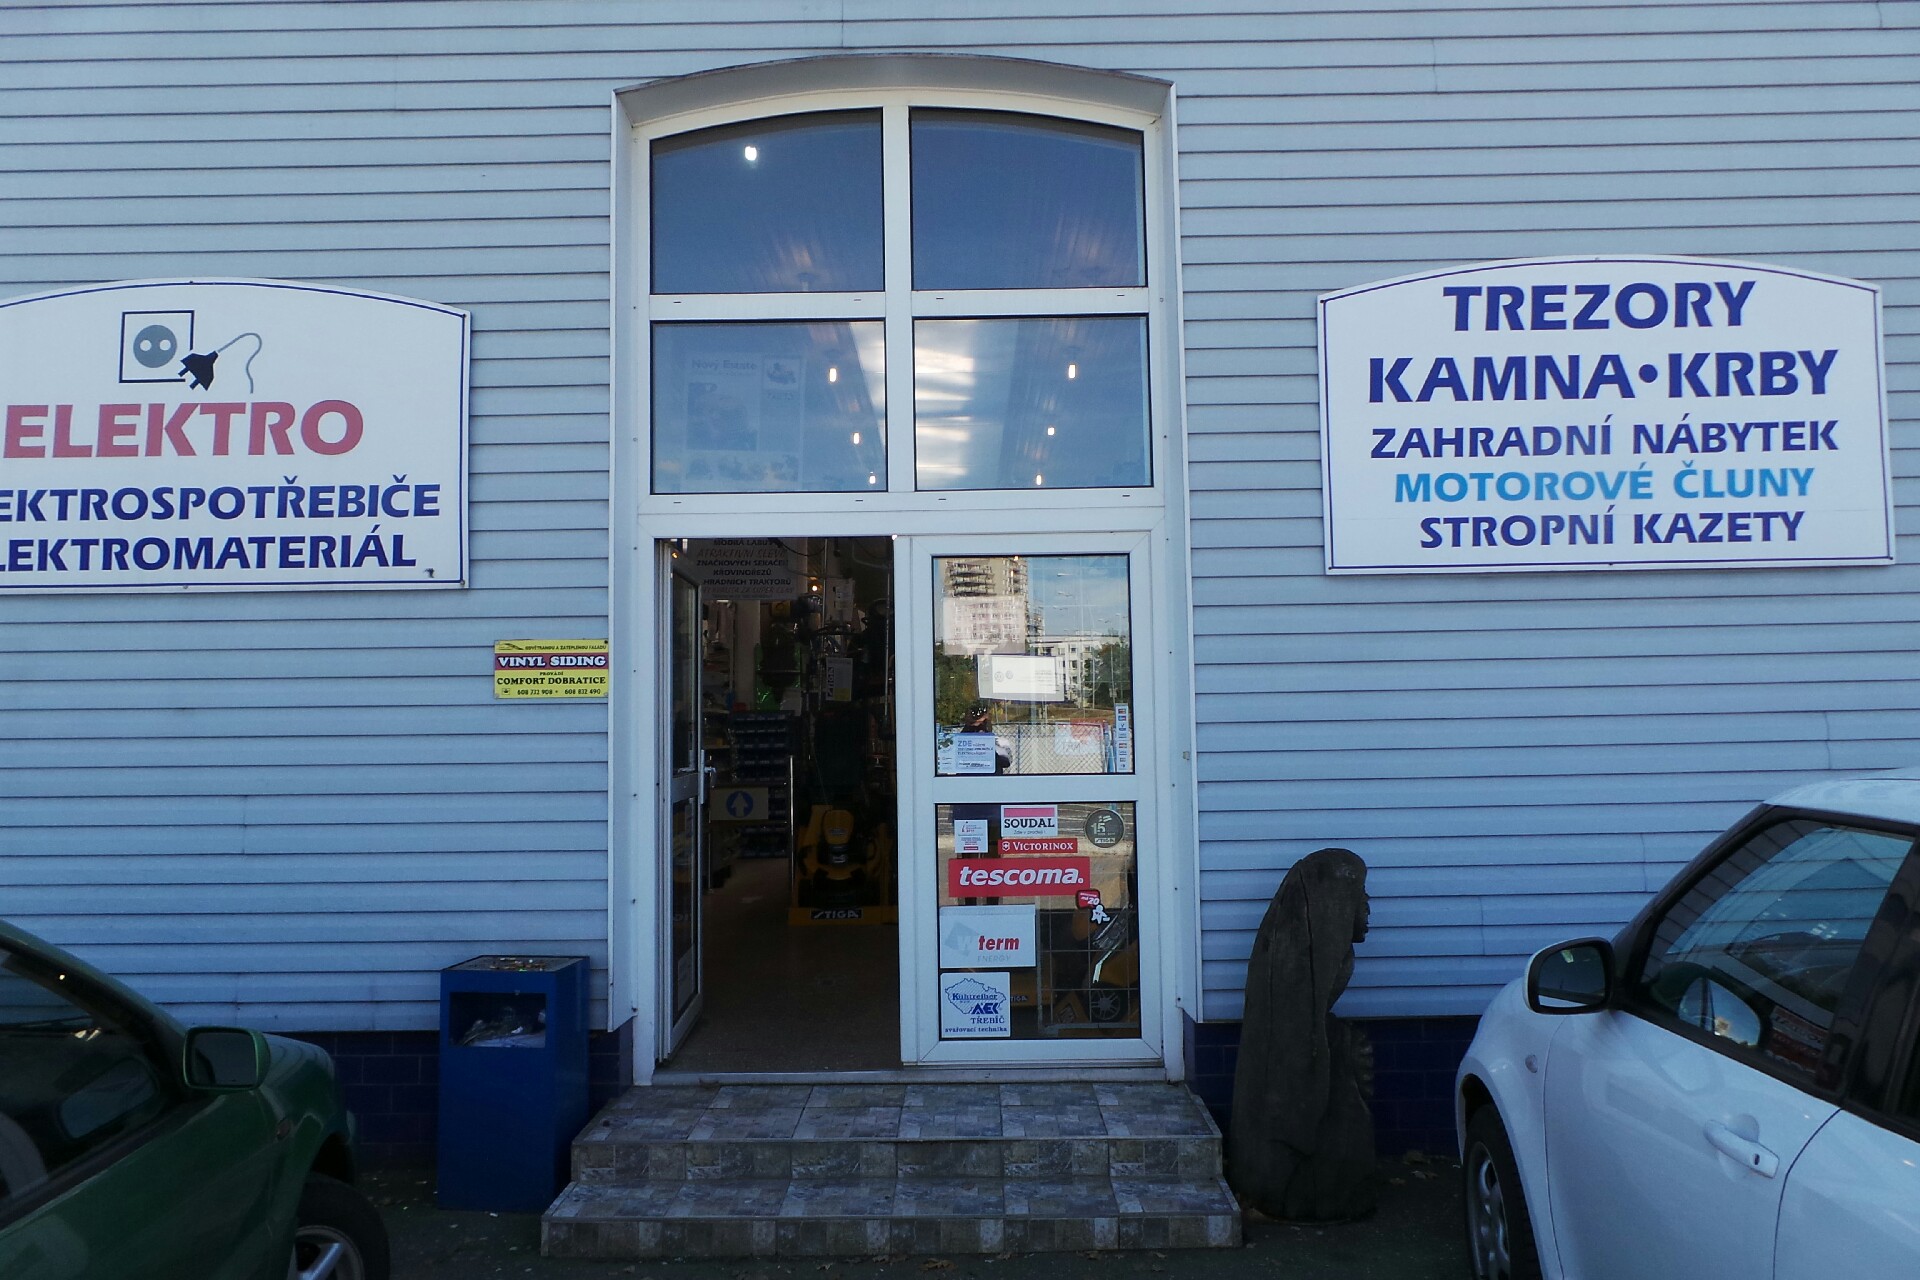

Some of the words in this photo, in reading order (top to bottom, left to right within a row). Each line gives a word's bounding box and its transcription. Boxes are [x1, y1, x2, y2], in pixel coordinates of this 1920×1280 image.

[1443, 281, 1756, 331] TREZORY
[3, 399, 364, 459] ELEKTRO
[1371, 413, 1612, 459] ZAHRADNÍ
[1632, 413, 1840, 455] NÁBYTEK
[1394, 462, 1654, 504] MOTOROVÉ
[1674, 460, 1816, 499] ČLUNY
[1420, 504, 1615, 549] STROPNÍ
[1633, 511, 1805, 545] KAZETY
[498, 656, 545, 667] VINYL
[550, 656, 606, 666] SIDING
[1004, 818, 1055, 829] SOUDAL
[959, 866, 1084, 886] tescoma.
[978, 935, 1020, 951] term
